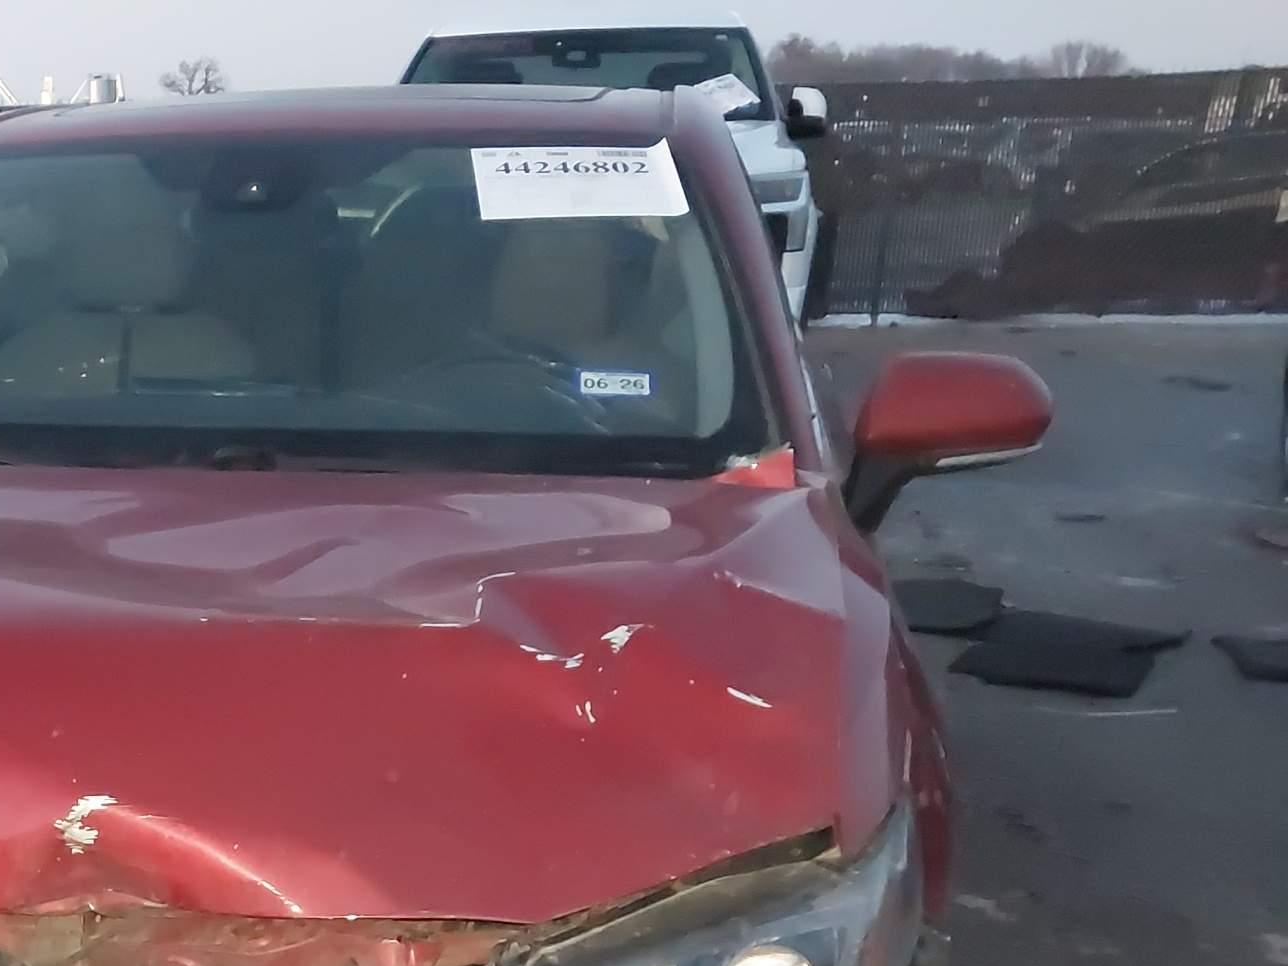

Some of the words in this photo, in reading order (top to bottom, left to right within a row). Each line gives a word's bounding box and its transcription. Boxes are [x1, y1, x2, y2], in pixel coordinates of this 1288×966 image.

[495, 161, 650, 174] 44246802
[583, 378, 609, 389] 06
[619, 379, 645, 390] 26
